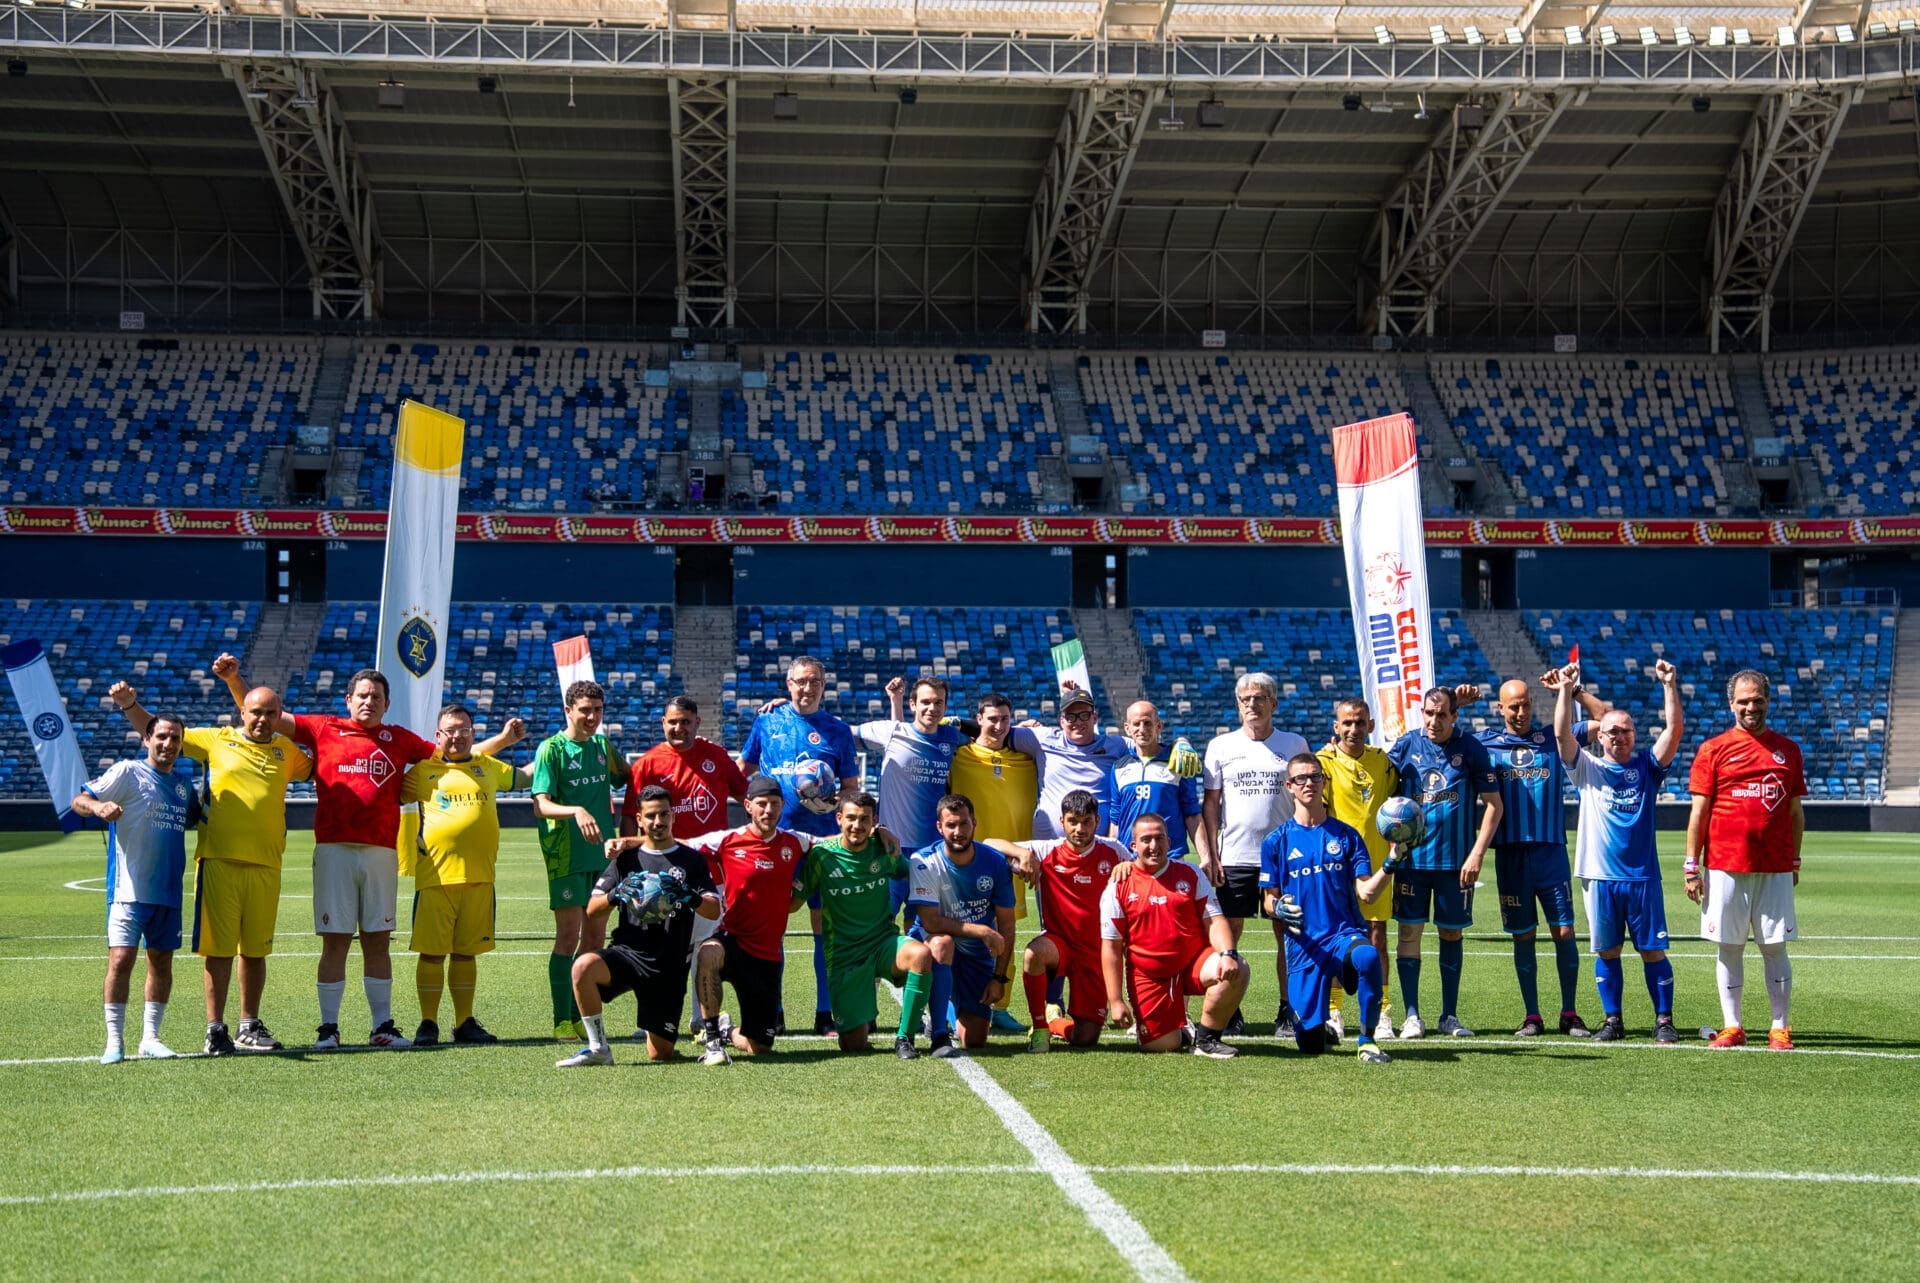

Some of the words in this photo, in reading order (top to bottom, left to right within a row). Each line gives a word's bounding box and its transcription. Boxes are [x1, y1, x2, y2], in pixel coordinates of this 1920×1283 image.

[8, 512, 70, 527] Winner
[87, 514, 149, 528] Winner
[169, 515, 231, 529] Winner
[251, 516, 312, 530] Winner
[332, 517, 388, 531] Winne
[491, 520, 550, 535] Winner
[570, 521, 629, 536] Winner
[648, 521, 706, 536] Winner
[726, 521, 784, 537] Winner
[802, 521, 860, 537] Winner
[879, 521, 937, 537] Winner
[956, 521, 1013, 537] Winner
[1031, 521, 1089, 537] Winner
[1107, 521, 1164, 537] Winner
[1182, 522, 1239, 538] Winner
[1258, 523, 1314, 538] Winner
[1424, 529, 1464, 538] nner
[1483, 524, 1539, 539] Winner
[1557, 524, 1614, 539] Winner
[1632, 524, 1689, 539] Winner
[1708, 525, 1764, 540] Winner
[1783, 525, 1844, 540] Winner
[1864, 524, 1920, 538] Winne
[1369, 612, 1400, 684] שווים
[1396, 607, 1424, 709] בכדורגל
[569, 774, 606, 787] VOLV
[1135, 784, 1150, 800] 98
[1289, 862, 1343, 878] VOLVO
[829, 877, 886, 896] VOLVO
